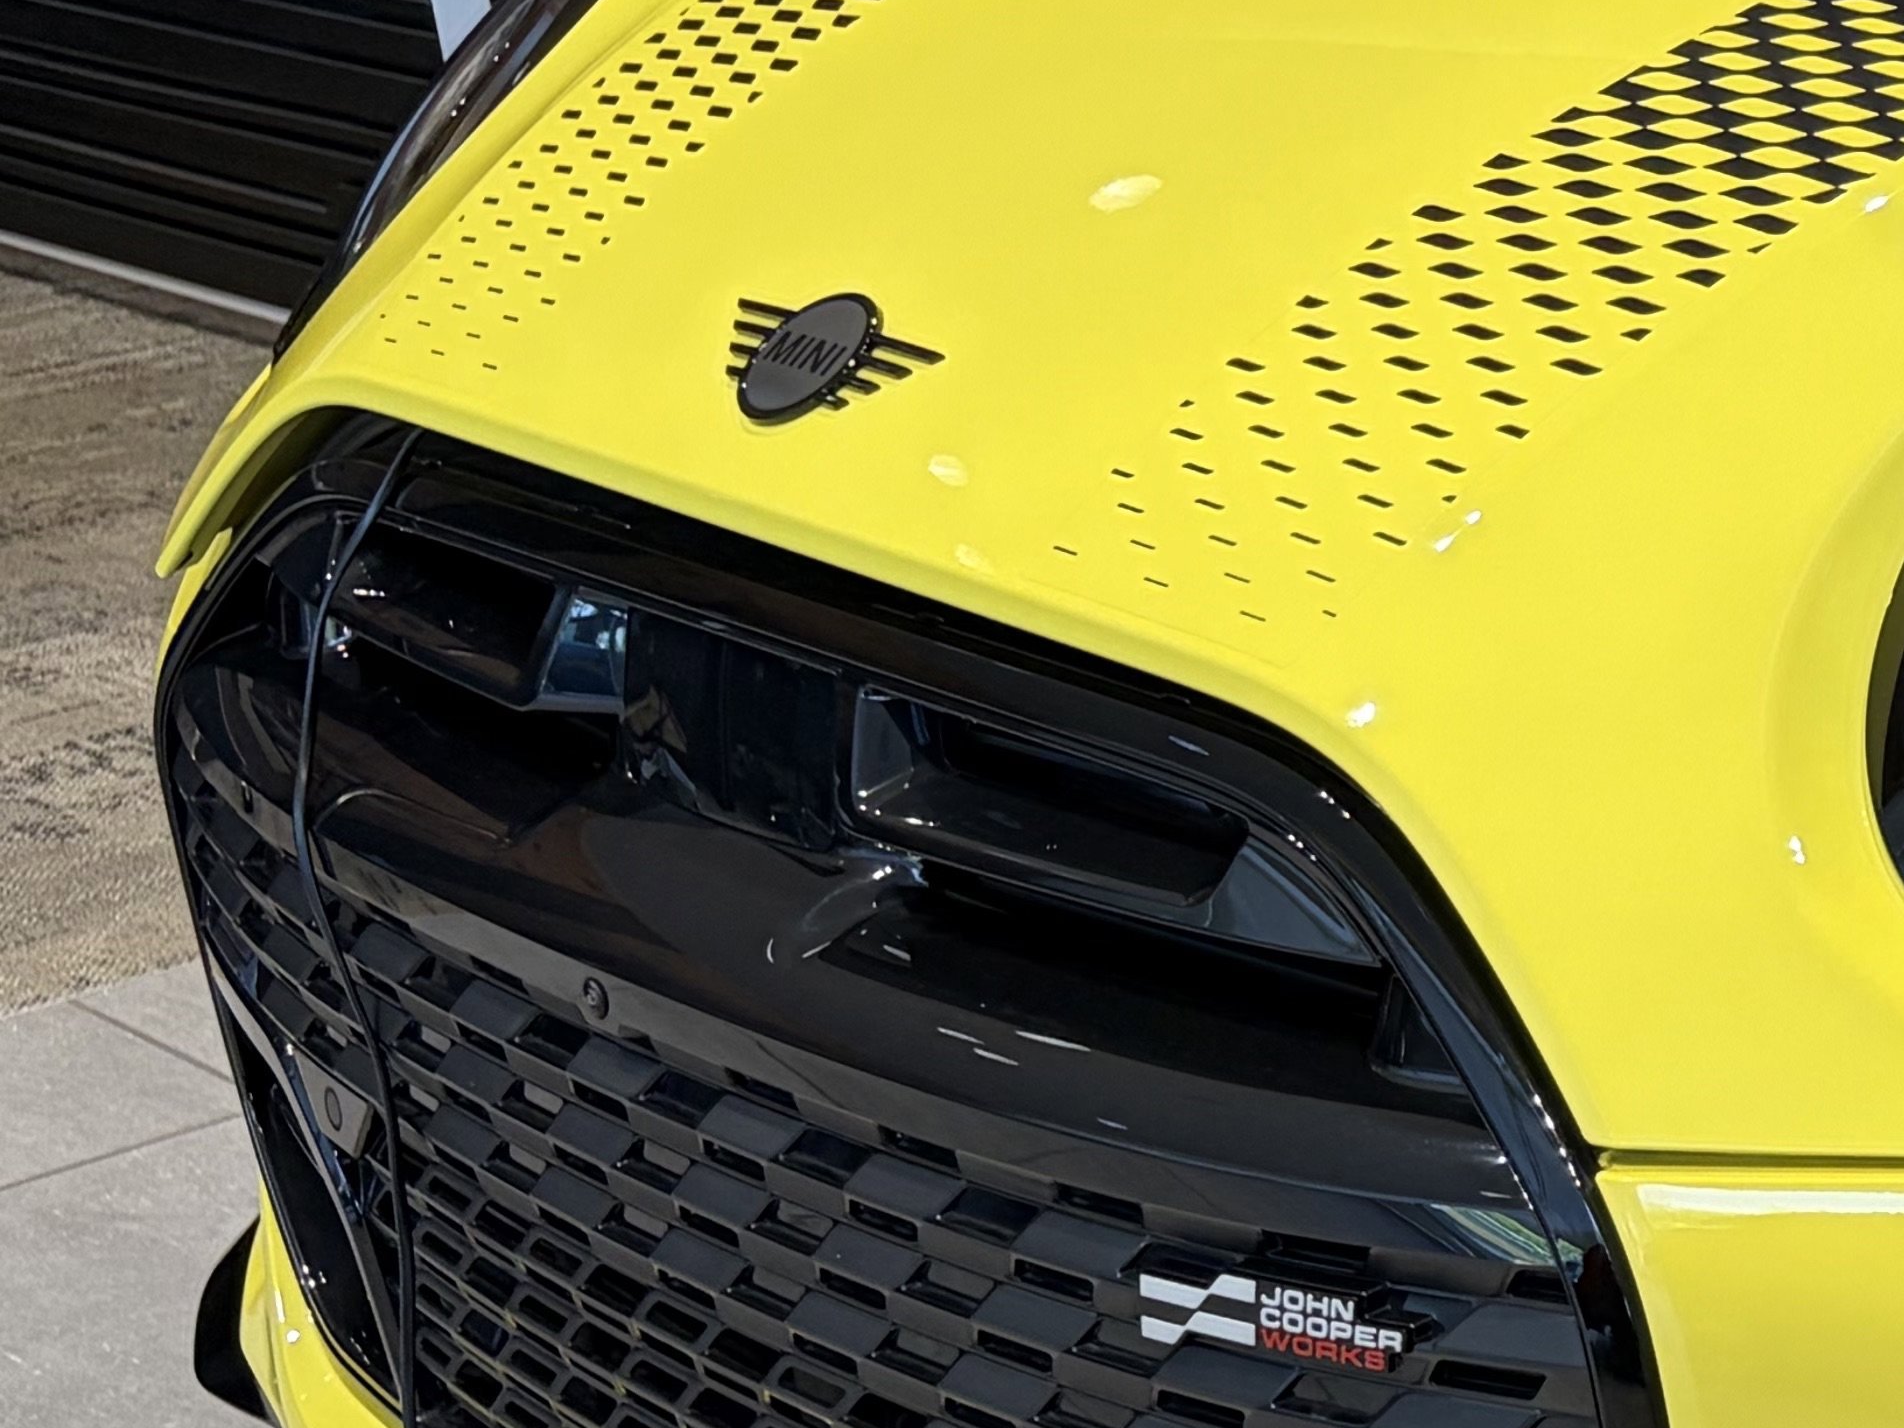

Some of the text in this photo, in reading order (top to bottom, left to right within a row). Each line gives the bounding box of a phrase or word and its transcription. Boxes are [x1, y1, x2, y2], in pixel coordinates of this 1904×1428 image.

[762, 330, 848, 377] MINI
[1260, 1285, 1355, 1321] JOHN
[1259, 1305, 1404, 1354] COOPER
[1261, 1328, 1386, 1372] WORKS
